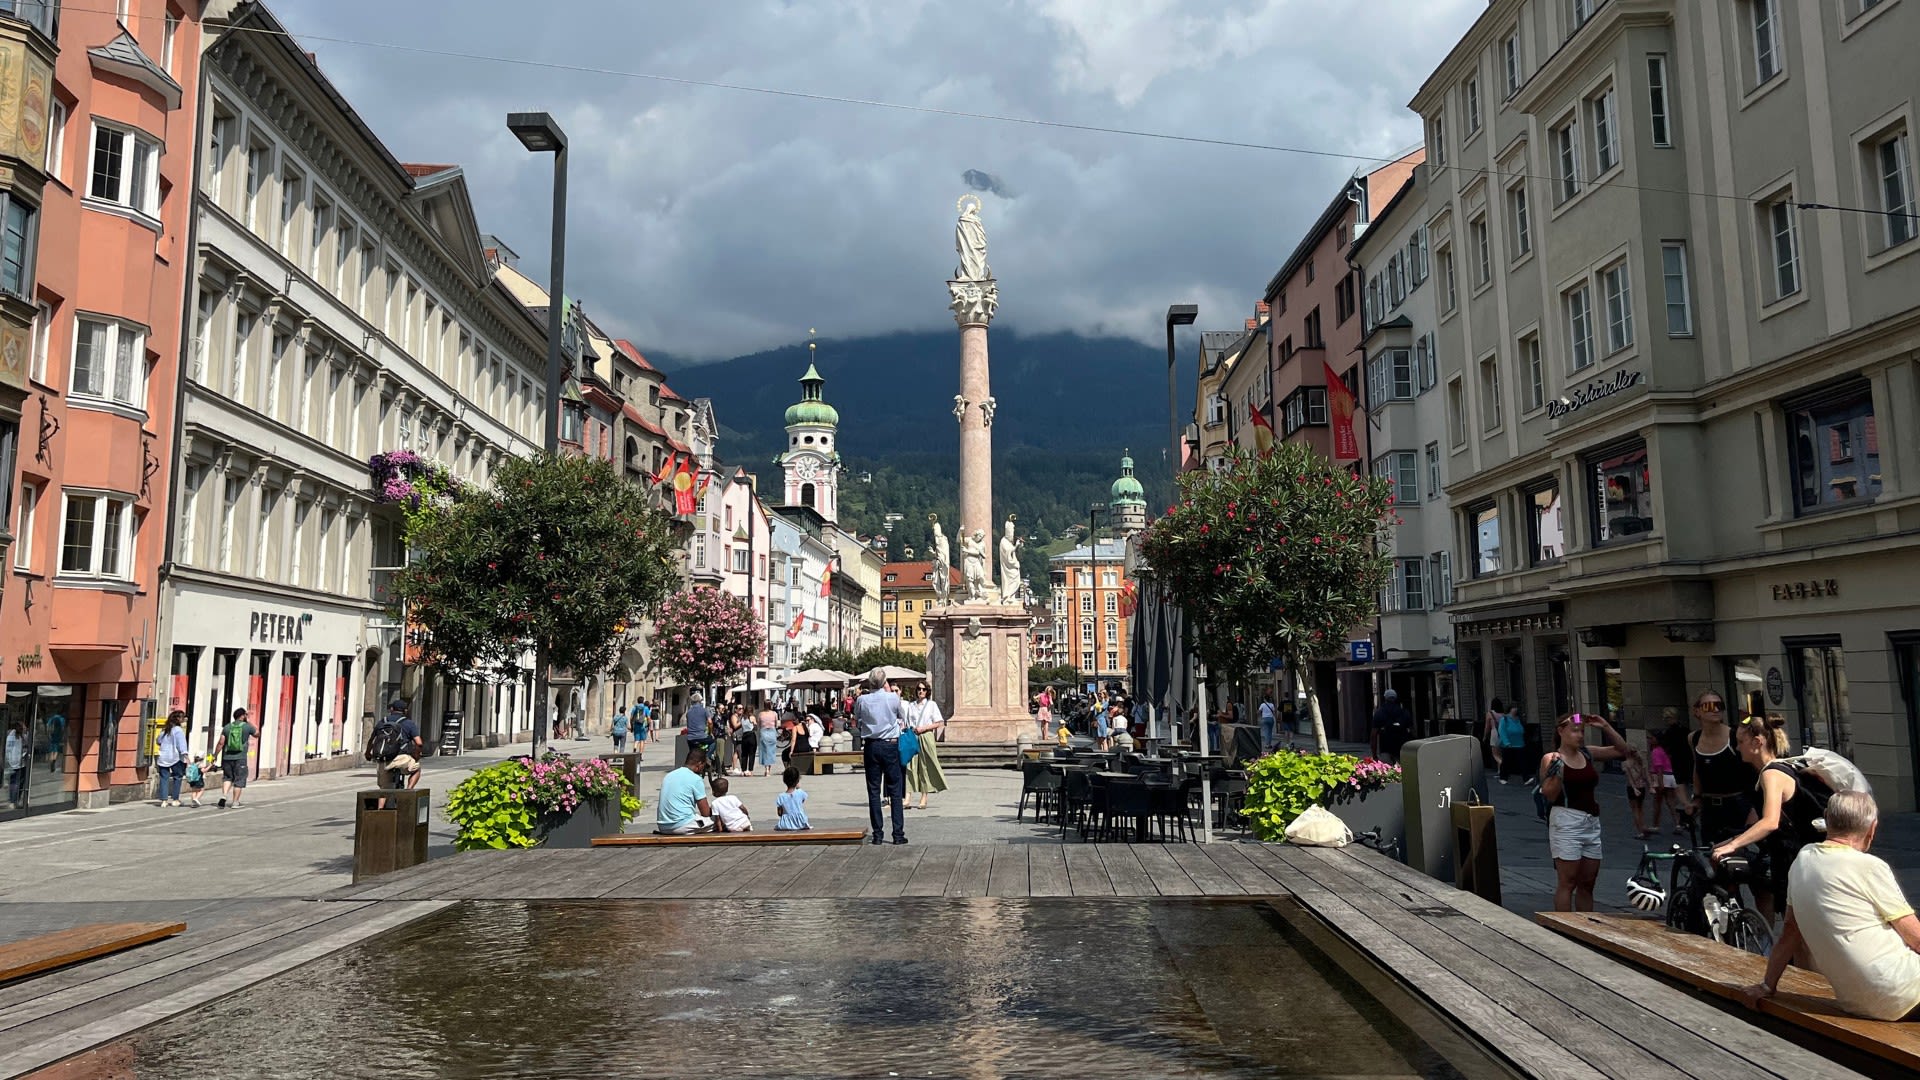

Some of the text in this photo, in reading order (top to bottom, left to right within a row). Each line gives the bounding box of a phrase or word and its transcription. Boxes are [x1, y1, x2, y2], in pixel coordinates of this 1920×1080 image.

[1546, 369, 1641, 420] Das Schindler
[1769, 578, 1839, 601] TABAK
[251, 611, 303, 645] PETERA
[1485, 615, 1561, 634] CENTRALE
